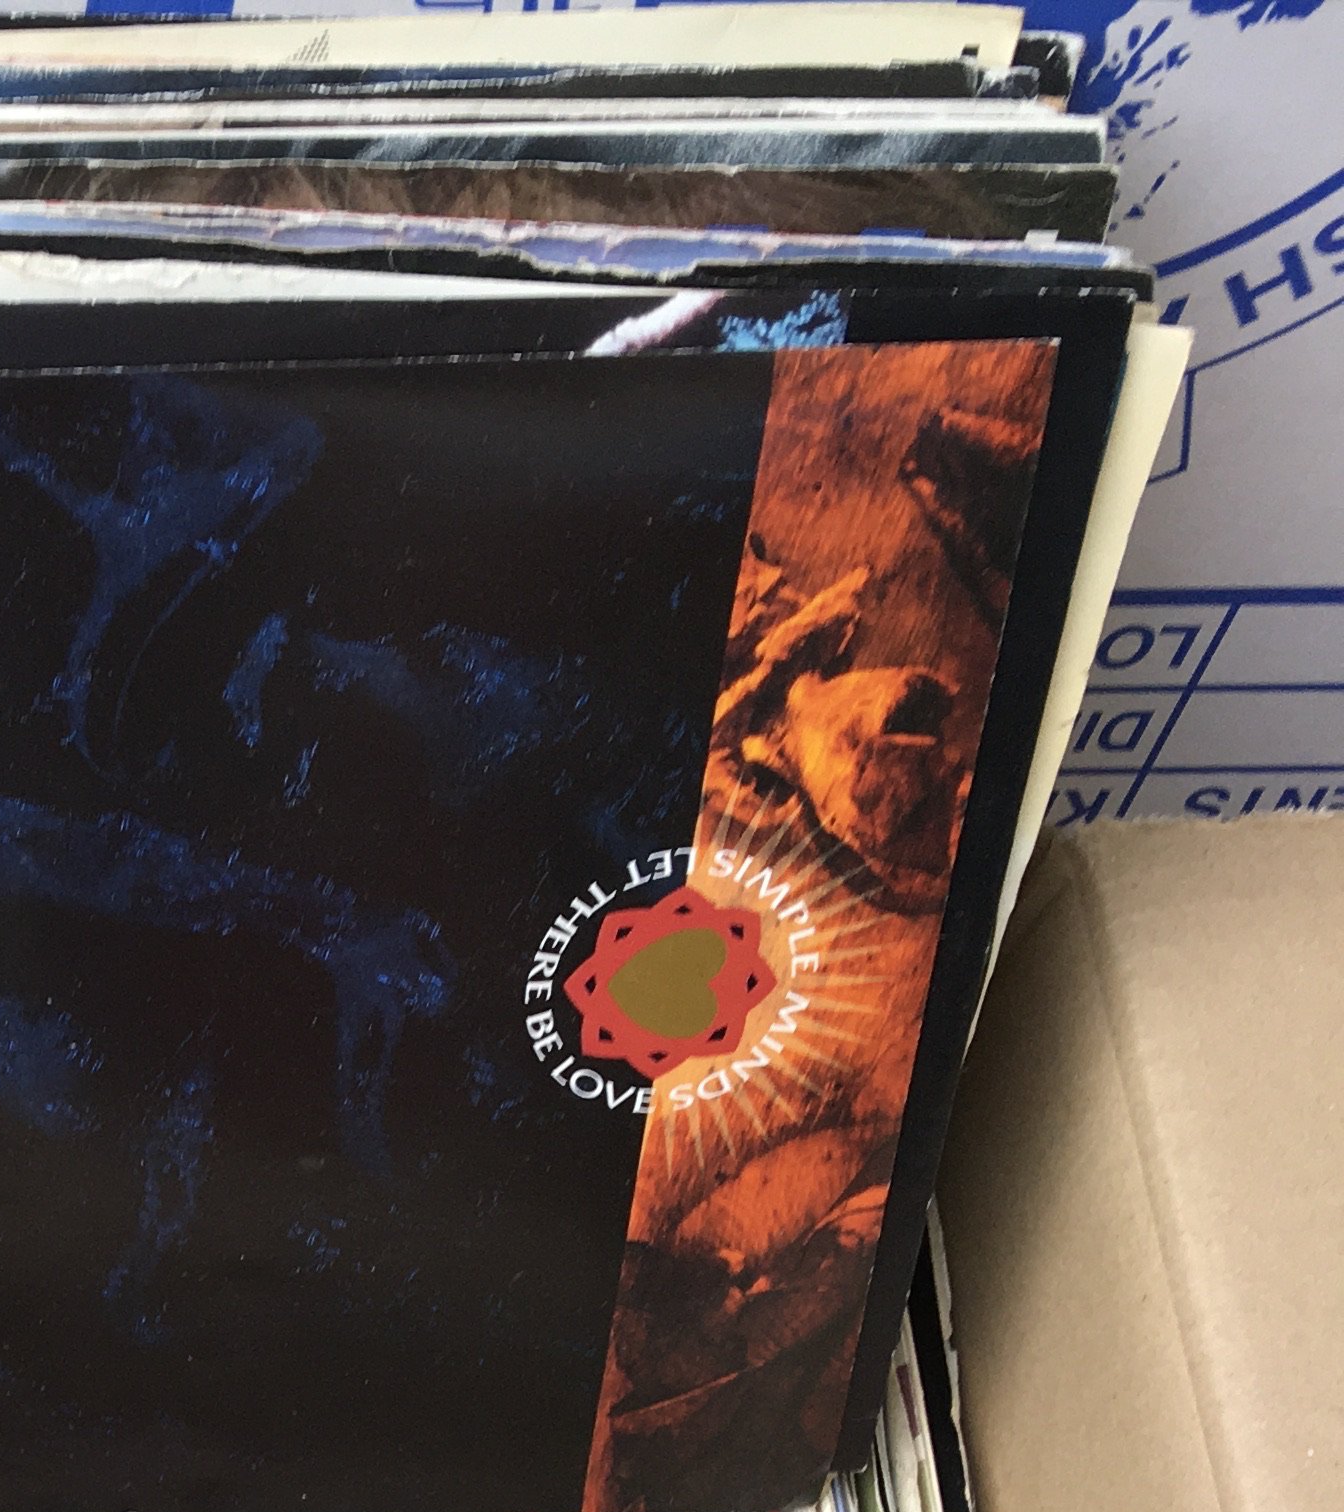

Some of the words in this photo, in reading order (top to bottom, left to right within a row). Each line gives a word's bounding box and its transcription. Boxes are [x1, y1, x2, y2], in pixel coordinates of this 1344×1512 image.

[623, 846, 696, 890] LET
[524, 881, 617, 1005] THERE
[708, 848, 820, 979] SIMPLE
[525, 1008, 564, 1062] BE
[668, 990, 811, 1112] MINDS
[550, 1055, 657, 1114] LOVE
